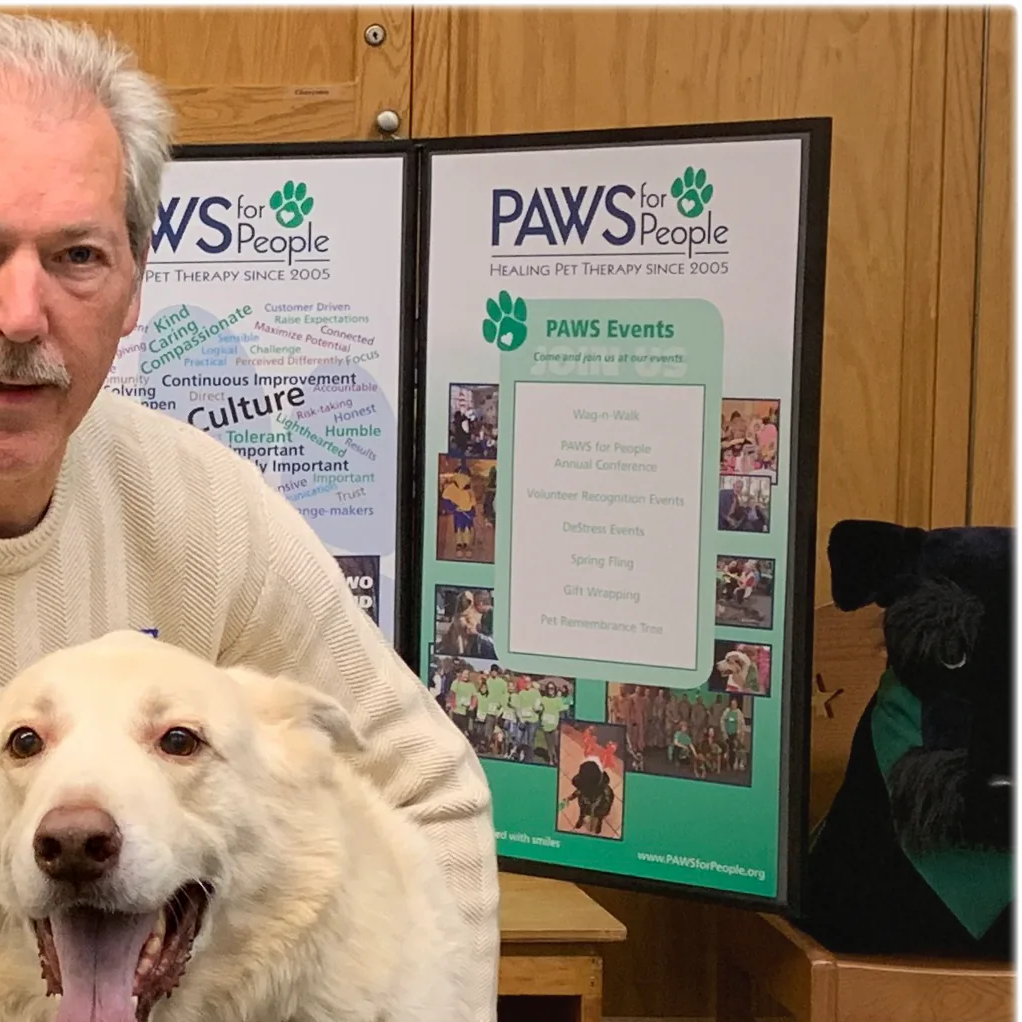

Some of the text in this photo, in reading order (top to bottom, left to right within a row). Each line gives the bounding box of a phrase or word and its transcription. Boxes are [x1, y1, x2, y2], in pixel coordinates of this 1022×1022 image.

[640, 182, 667, 208] for
[237, 194, 265, 219] for
[491, 185, 636, 246] PAWS
[151, 196, 232, 254] WS
[641, 210, 729, 259] People
[237, 222, 330, 266] People
[145, 268, 331, 283] PET THERAPY SINCE 2005
[490, 261, 729, 277] HEALING PET THERAPY SINCE 2005
[264, 302, 351, 313] Customer Driven
[154, 304, 190, 333] Kind
[274, 314, 369, 325] Raise Expectations
[320, 325, 376, 346] Connected
[546, 319, 675, 338] PAWS Events
[140, 303, 254, 375] Compassionate
[148, 320, 199, 354] Caring
[217, 333, 260, 343] Sensible
[254, 321, 352, 353] Maximize Potential
[201, 345, 238, 356] Logical
[249, 344, 302, 355] Challenge
[533, 351, 561, 362] Come
[562, 352, 581, 362] and
[582, 352, 602, 364] join
[604, 353, 615, 363] us
[617, 352, 628, 363] at
[630, 353, 649, 363] our
[184, 357, 227, 367] Practical
[235, 355, 345, 367] Perceived Differently
[345, 350, 380, 366] Focus
[162, 372, 357, 389] Continuous Improvement
[312, 383, 378, 393] Accountable
[189, 391, 226, 402] Direct
[187, 386, 305, 432] Culture
[296, 399, 353, 420] Risk-taking
[334, 404, 377, 423] Honest
[572, 409, 640, 422] Wag-n-Walk
[226, 429, 293, 443] Tolerant
[276, 412, 347, 458] Lighthearted
[325, 424, 381, 437] Humble
[344, 437, 377, 461] Results
[560, 440, 652, 456] PAWS for People
[273, 460, 349, 475] Important
[553, 458, 658, 473] Annual Conference
[277, 478, 308, 493] nsive
[313, 473, 375, 484] Important
[336, 486, 366, 502] Trust
[526, 488, 685, 507] Volunteer Recognition Events
[562, 521, 645, 537] DeStress Events
[570, 553, 635, 571] Spring Fling
[563, 584, 641, 603] Gift Wrapping
[540, 614, 664, 635] Pet Remembrance Tree
[509, 832, 530, 843] with
[532, 836, 560, 848] smiles
[637, 851, 766, 881] www.PAWSforPeople.org
